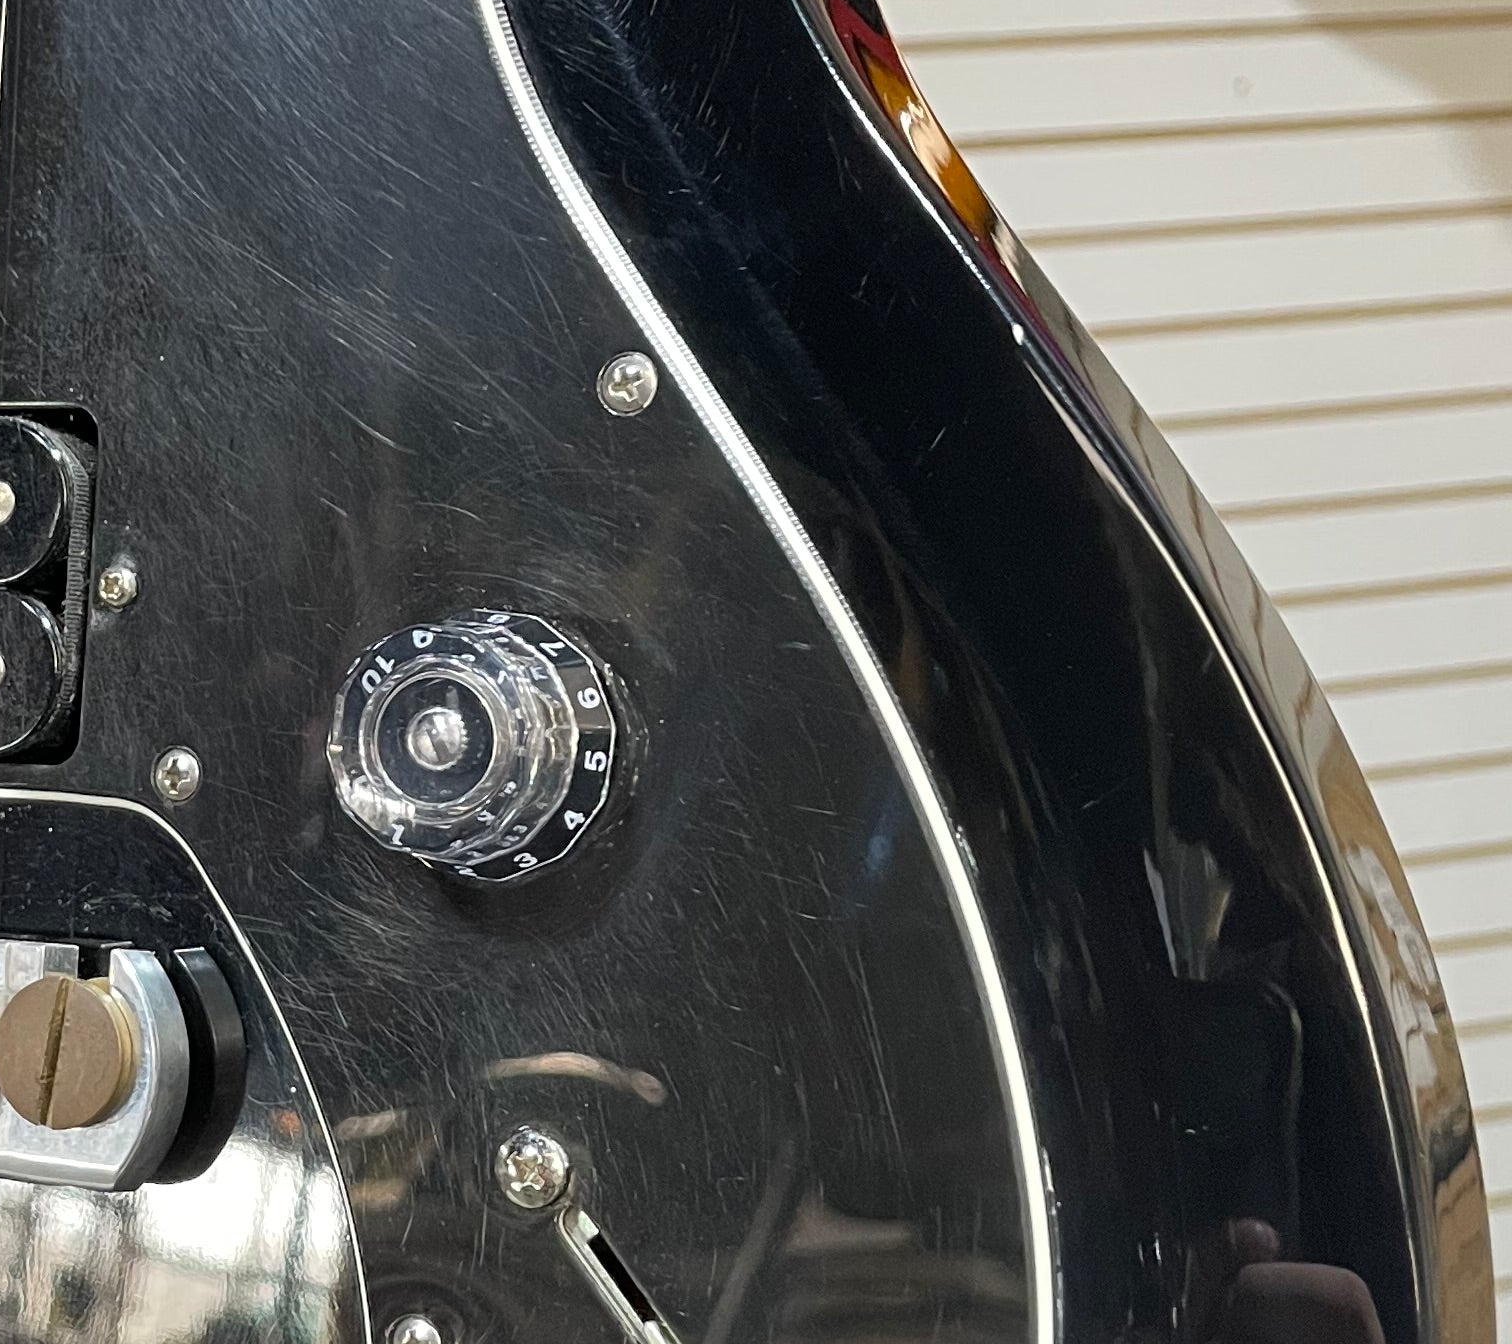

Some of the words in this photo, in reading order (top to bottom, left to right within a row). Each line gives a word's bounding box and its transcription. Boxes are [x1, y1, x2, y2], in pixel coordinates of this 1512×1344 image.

[540, 641, 565, 657] 7
[361, 655, 395, 694] 10
[576, 687, 601, 709] 6
[584, 750, 607, 772] 5
[563, 809, 586, 831] 4
[513, 852, 538, 868] 3
